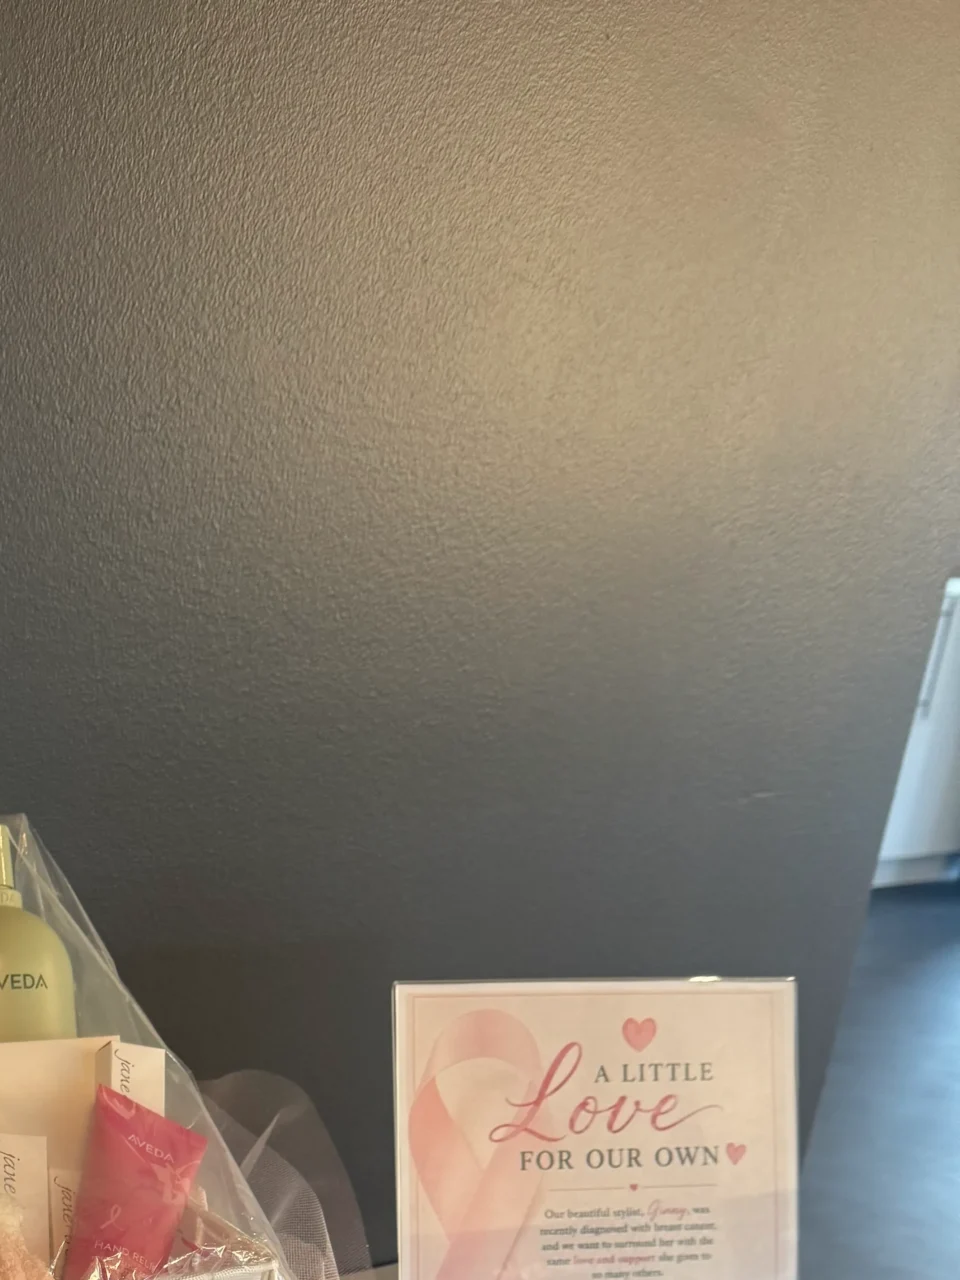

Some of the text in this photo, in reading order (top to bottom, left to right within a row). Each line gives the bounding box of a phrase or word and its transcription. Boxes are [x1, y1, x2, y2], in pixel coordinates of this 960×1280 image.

[114, 1048, 135, 1093] jane
[594, 1062, 714, 1083] A LITTLE
[488, 1042, 724, 1142] Love
[127, 1134, 175, 1164] AVEDA
[520, 1145, 720, 1171] FOR OUR OWN
[544, 1209, 564, 1219] Our
[567, 1207, 610, 1218] beautiful
[692, 1206, 710, 1214] was
[540, 1225, 577, 1238] recently
[580, 1224, 628, 1236] diagnosed
[630, 1222, 651, 1232] with
[94, 1240, 156, 1272] HAND RELI
[542, 1241, 559, 1251] and
[602, 1240, 612, 1249] to
[658, 1238, 675, 1247] her
[677, 1236, 697, 1246] with
